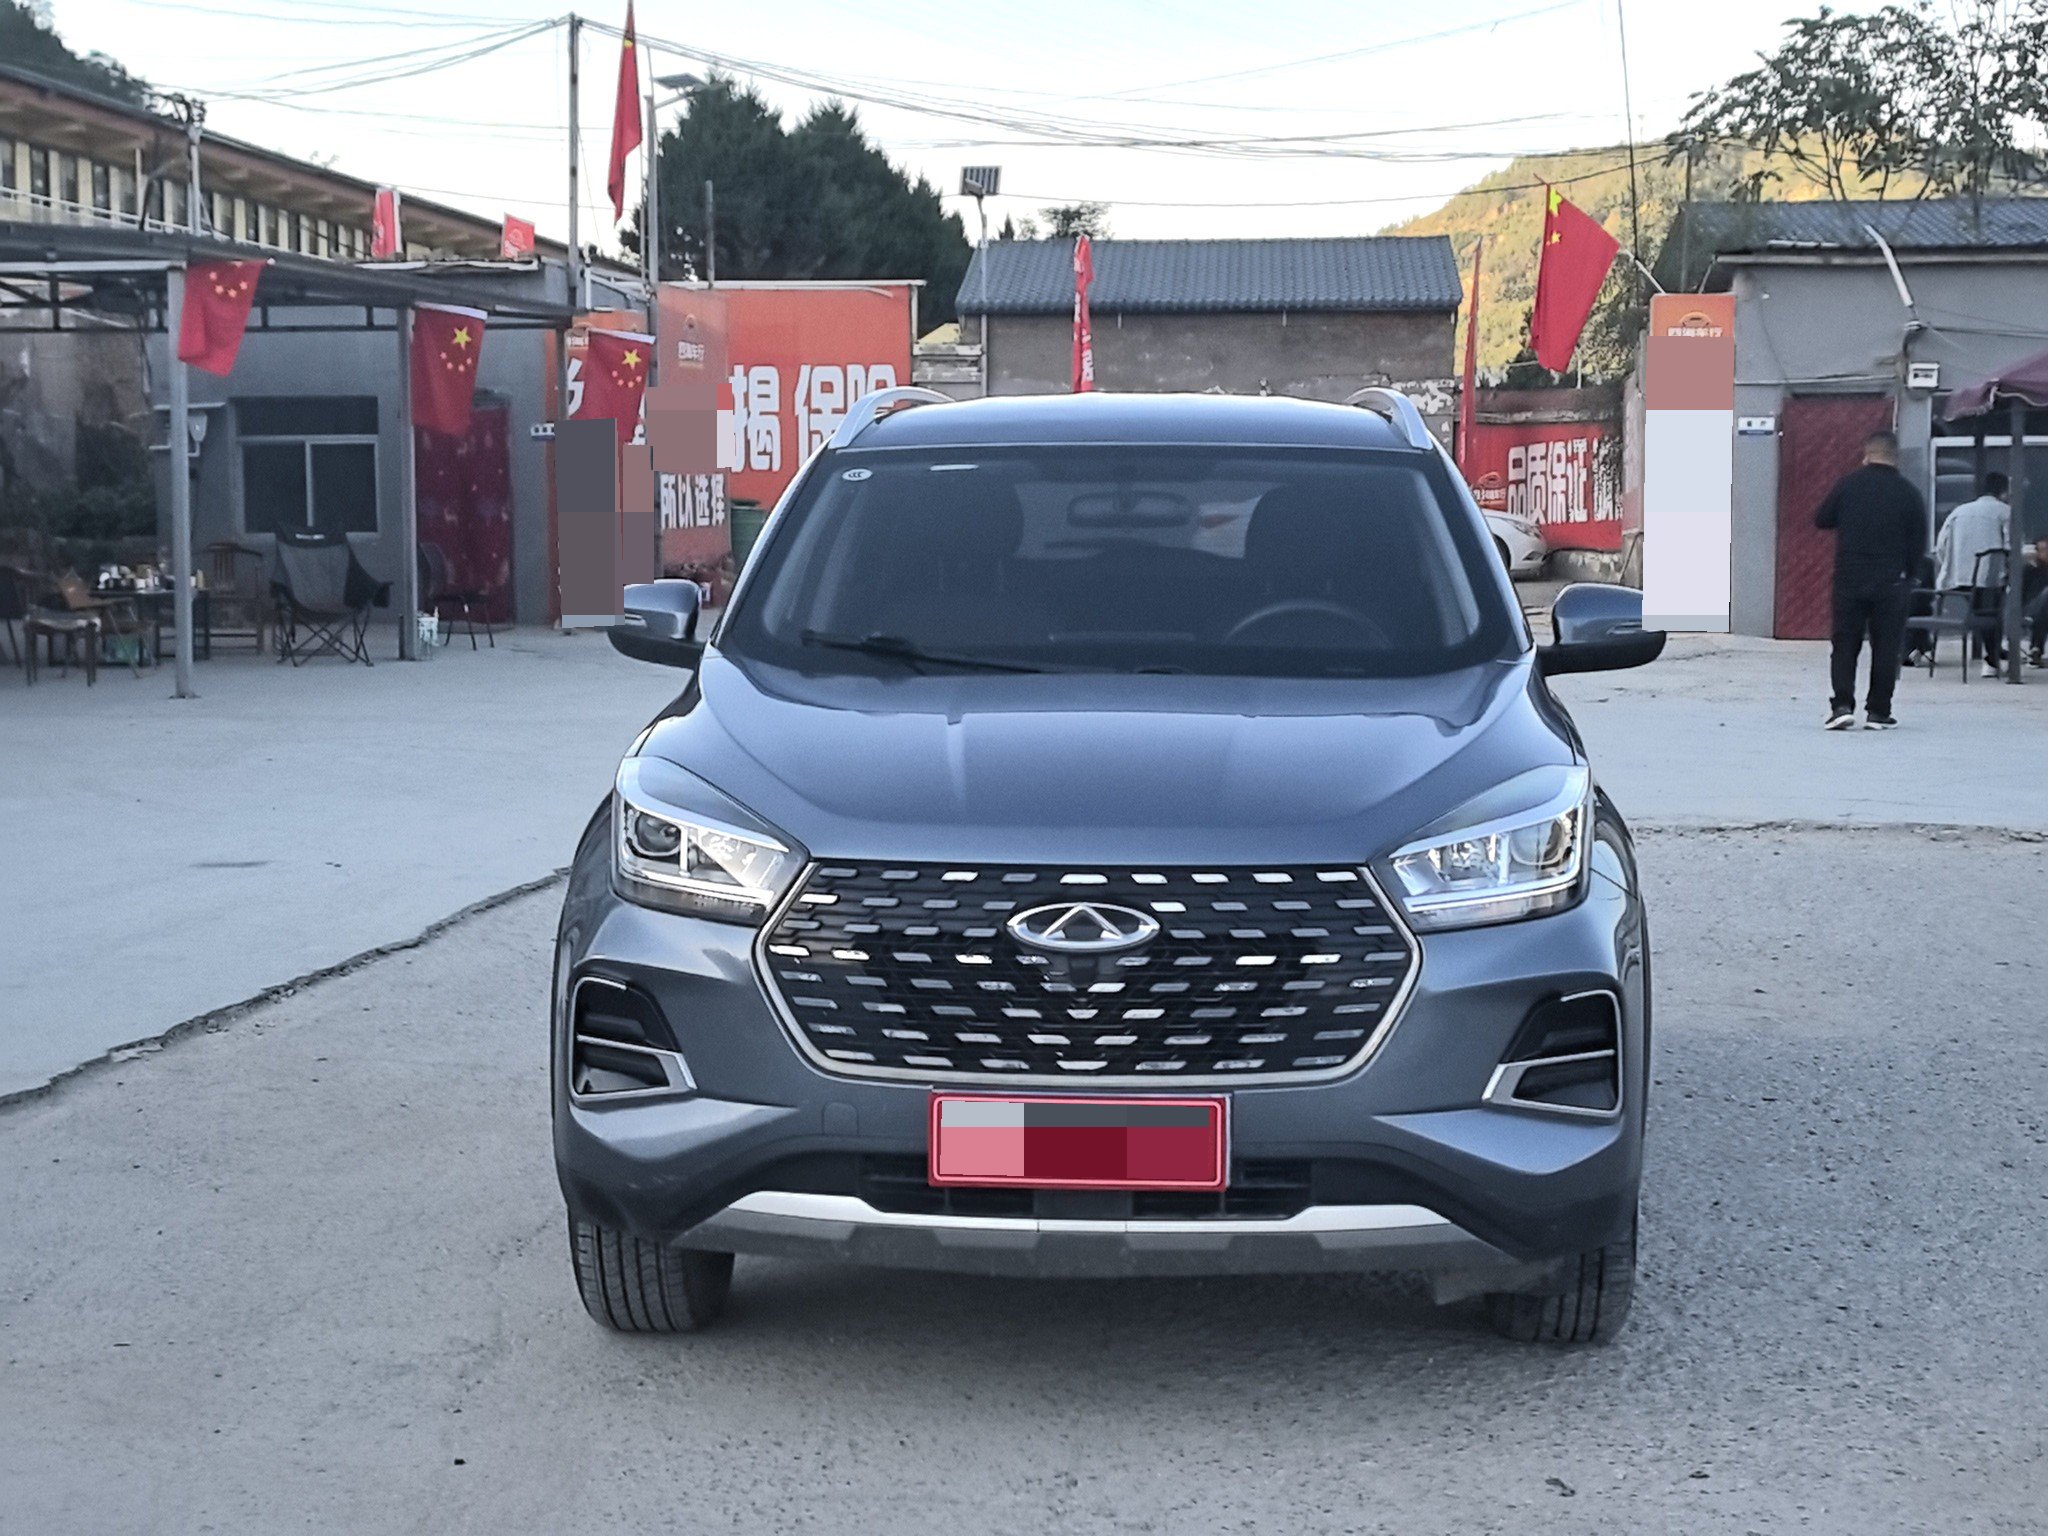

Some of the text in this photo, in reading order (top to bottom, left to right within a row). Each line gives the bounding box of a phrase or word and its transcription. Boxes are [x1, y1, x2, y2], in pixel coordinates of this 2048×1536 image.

[660, 473, 724, 529] 所以选择
[1507, 437, 1588, 525] 品质保证
